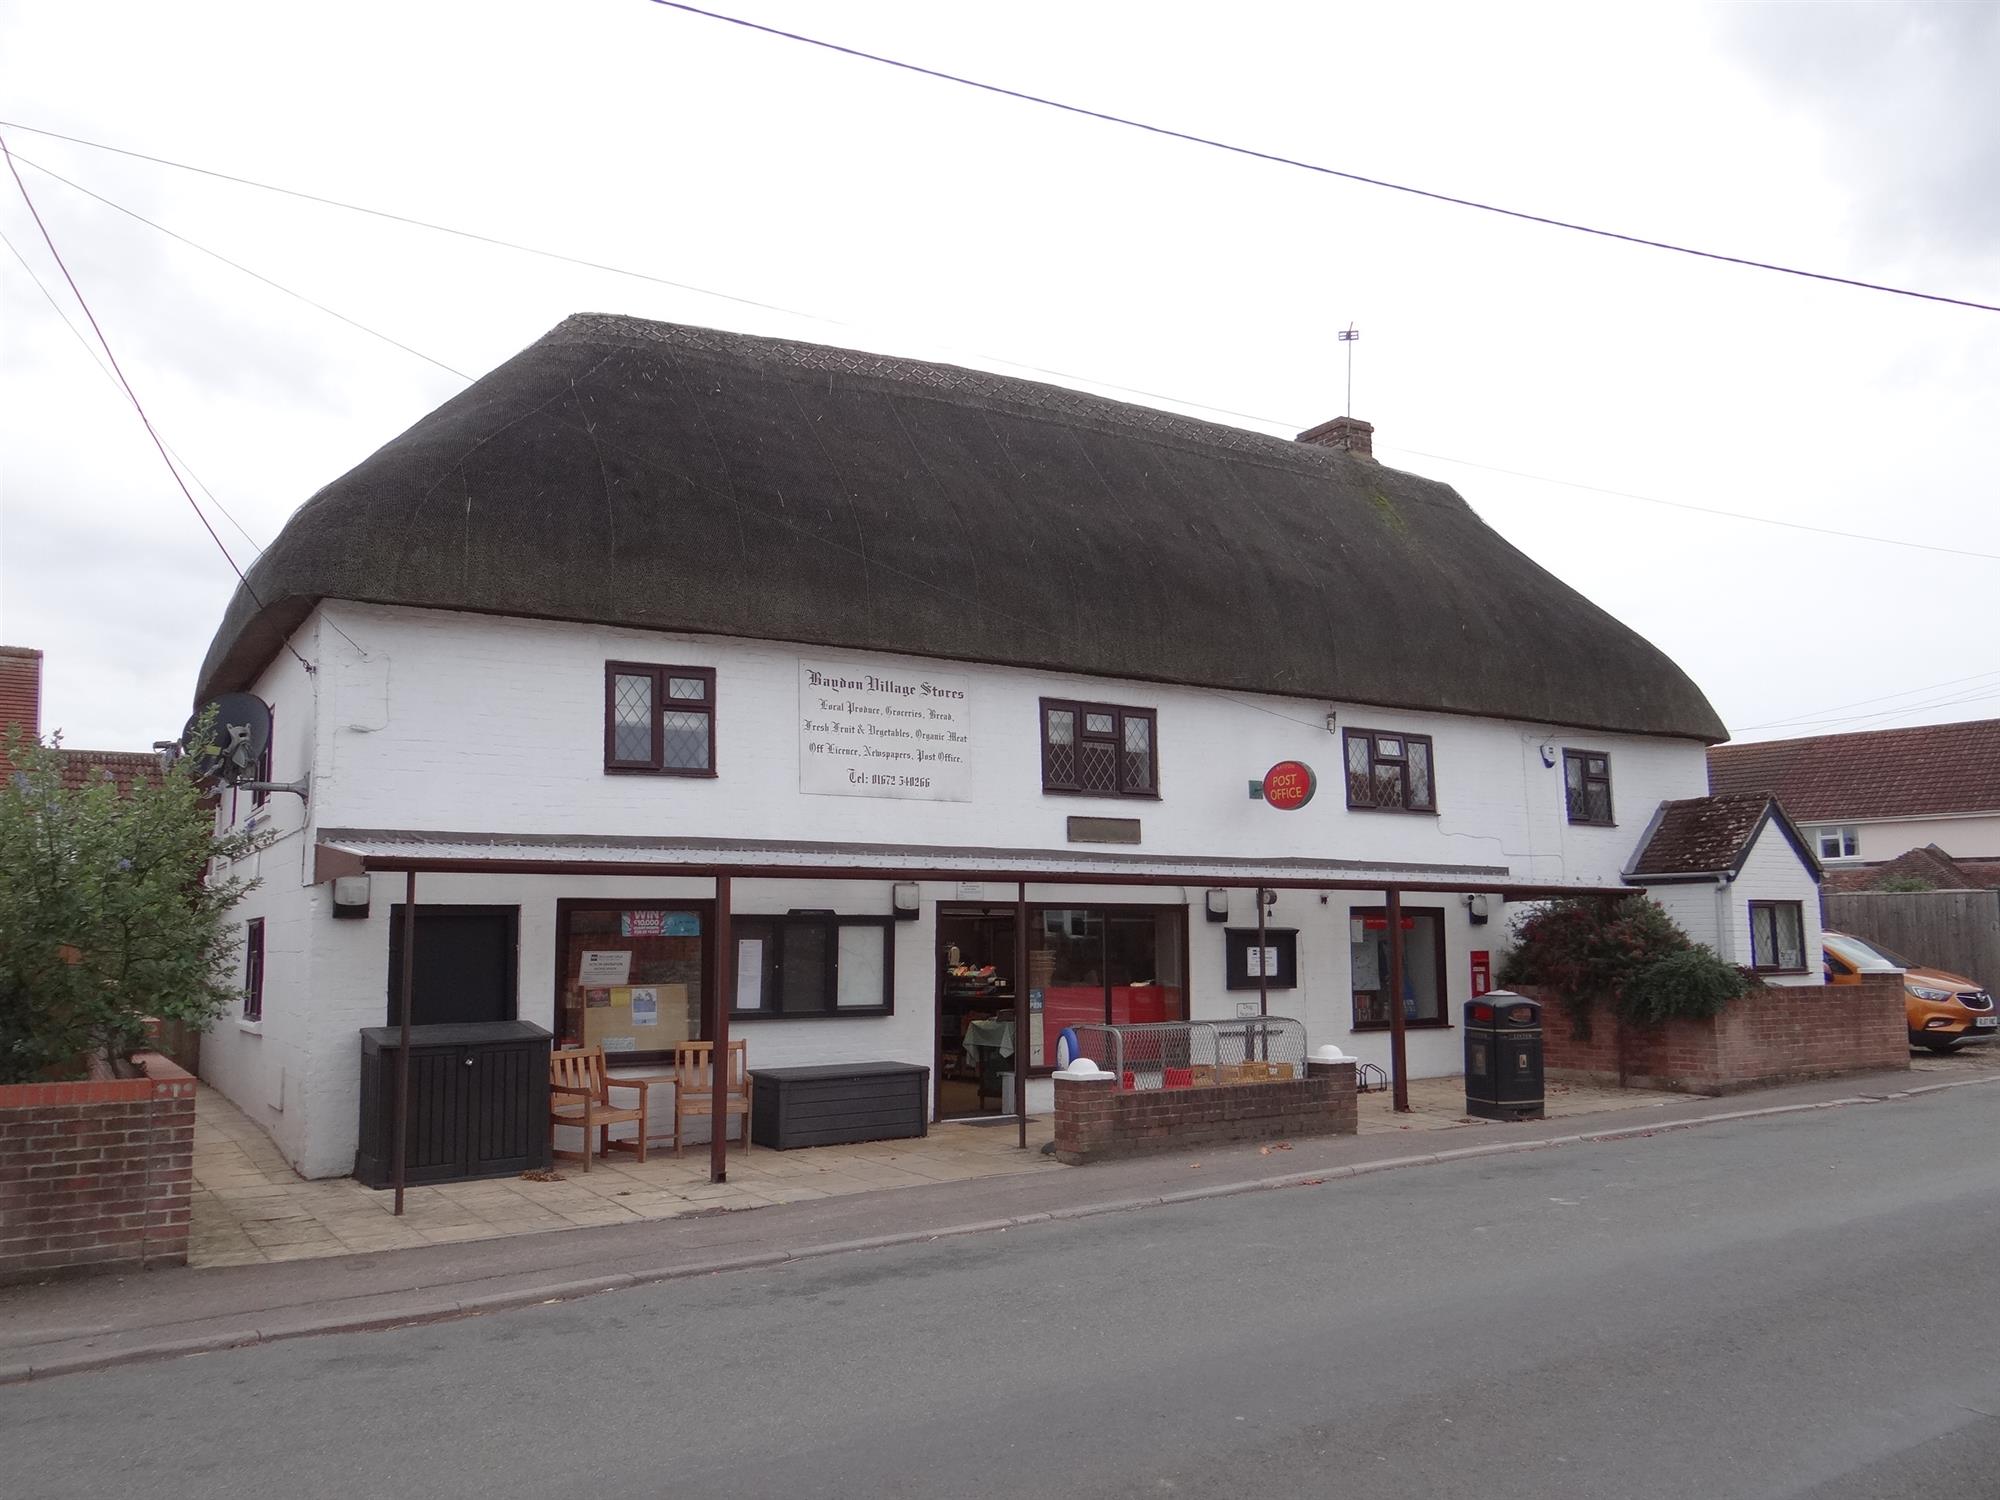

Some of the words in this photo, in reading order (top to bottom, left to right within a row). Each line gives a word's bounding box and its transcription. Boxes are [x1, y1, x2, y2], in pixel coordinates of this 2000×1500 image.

[805, 669, 863, 692] Baydon
[864, 675, 916, 697] Village
[920, 681, 964, 699] Stores
[818, 698, 844, 712] Local
[803, 719, 829, 732] Fresh
[832, 721, 855, 733] Fruit
[857, 723, 865, 735] &
[915, 729, 945, 742] Organic
[946, 730, 967, 743] Meat
[808, 742, 824, 754] Off
[916, 749, 937, 763] Post
[847, 768, 869, 784] Tel:
[871, 774, 896, 786] 01672
[1272, 773, 1297, 787] POST
[1270, 786, 1303, 801] OFFICE
[634, 911, 660, 920] WIN
